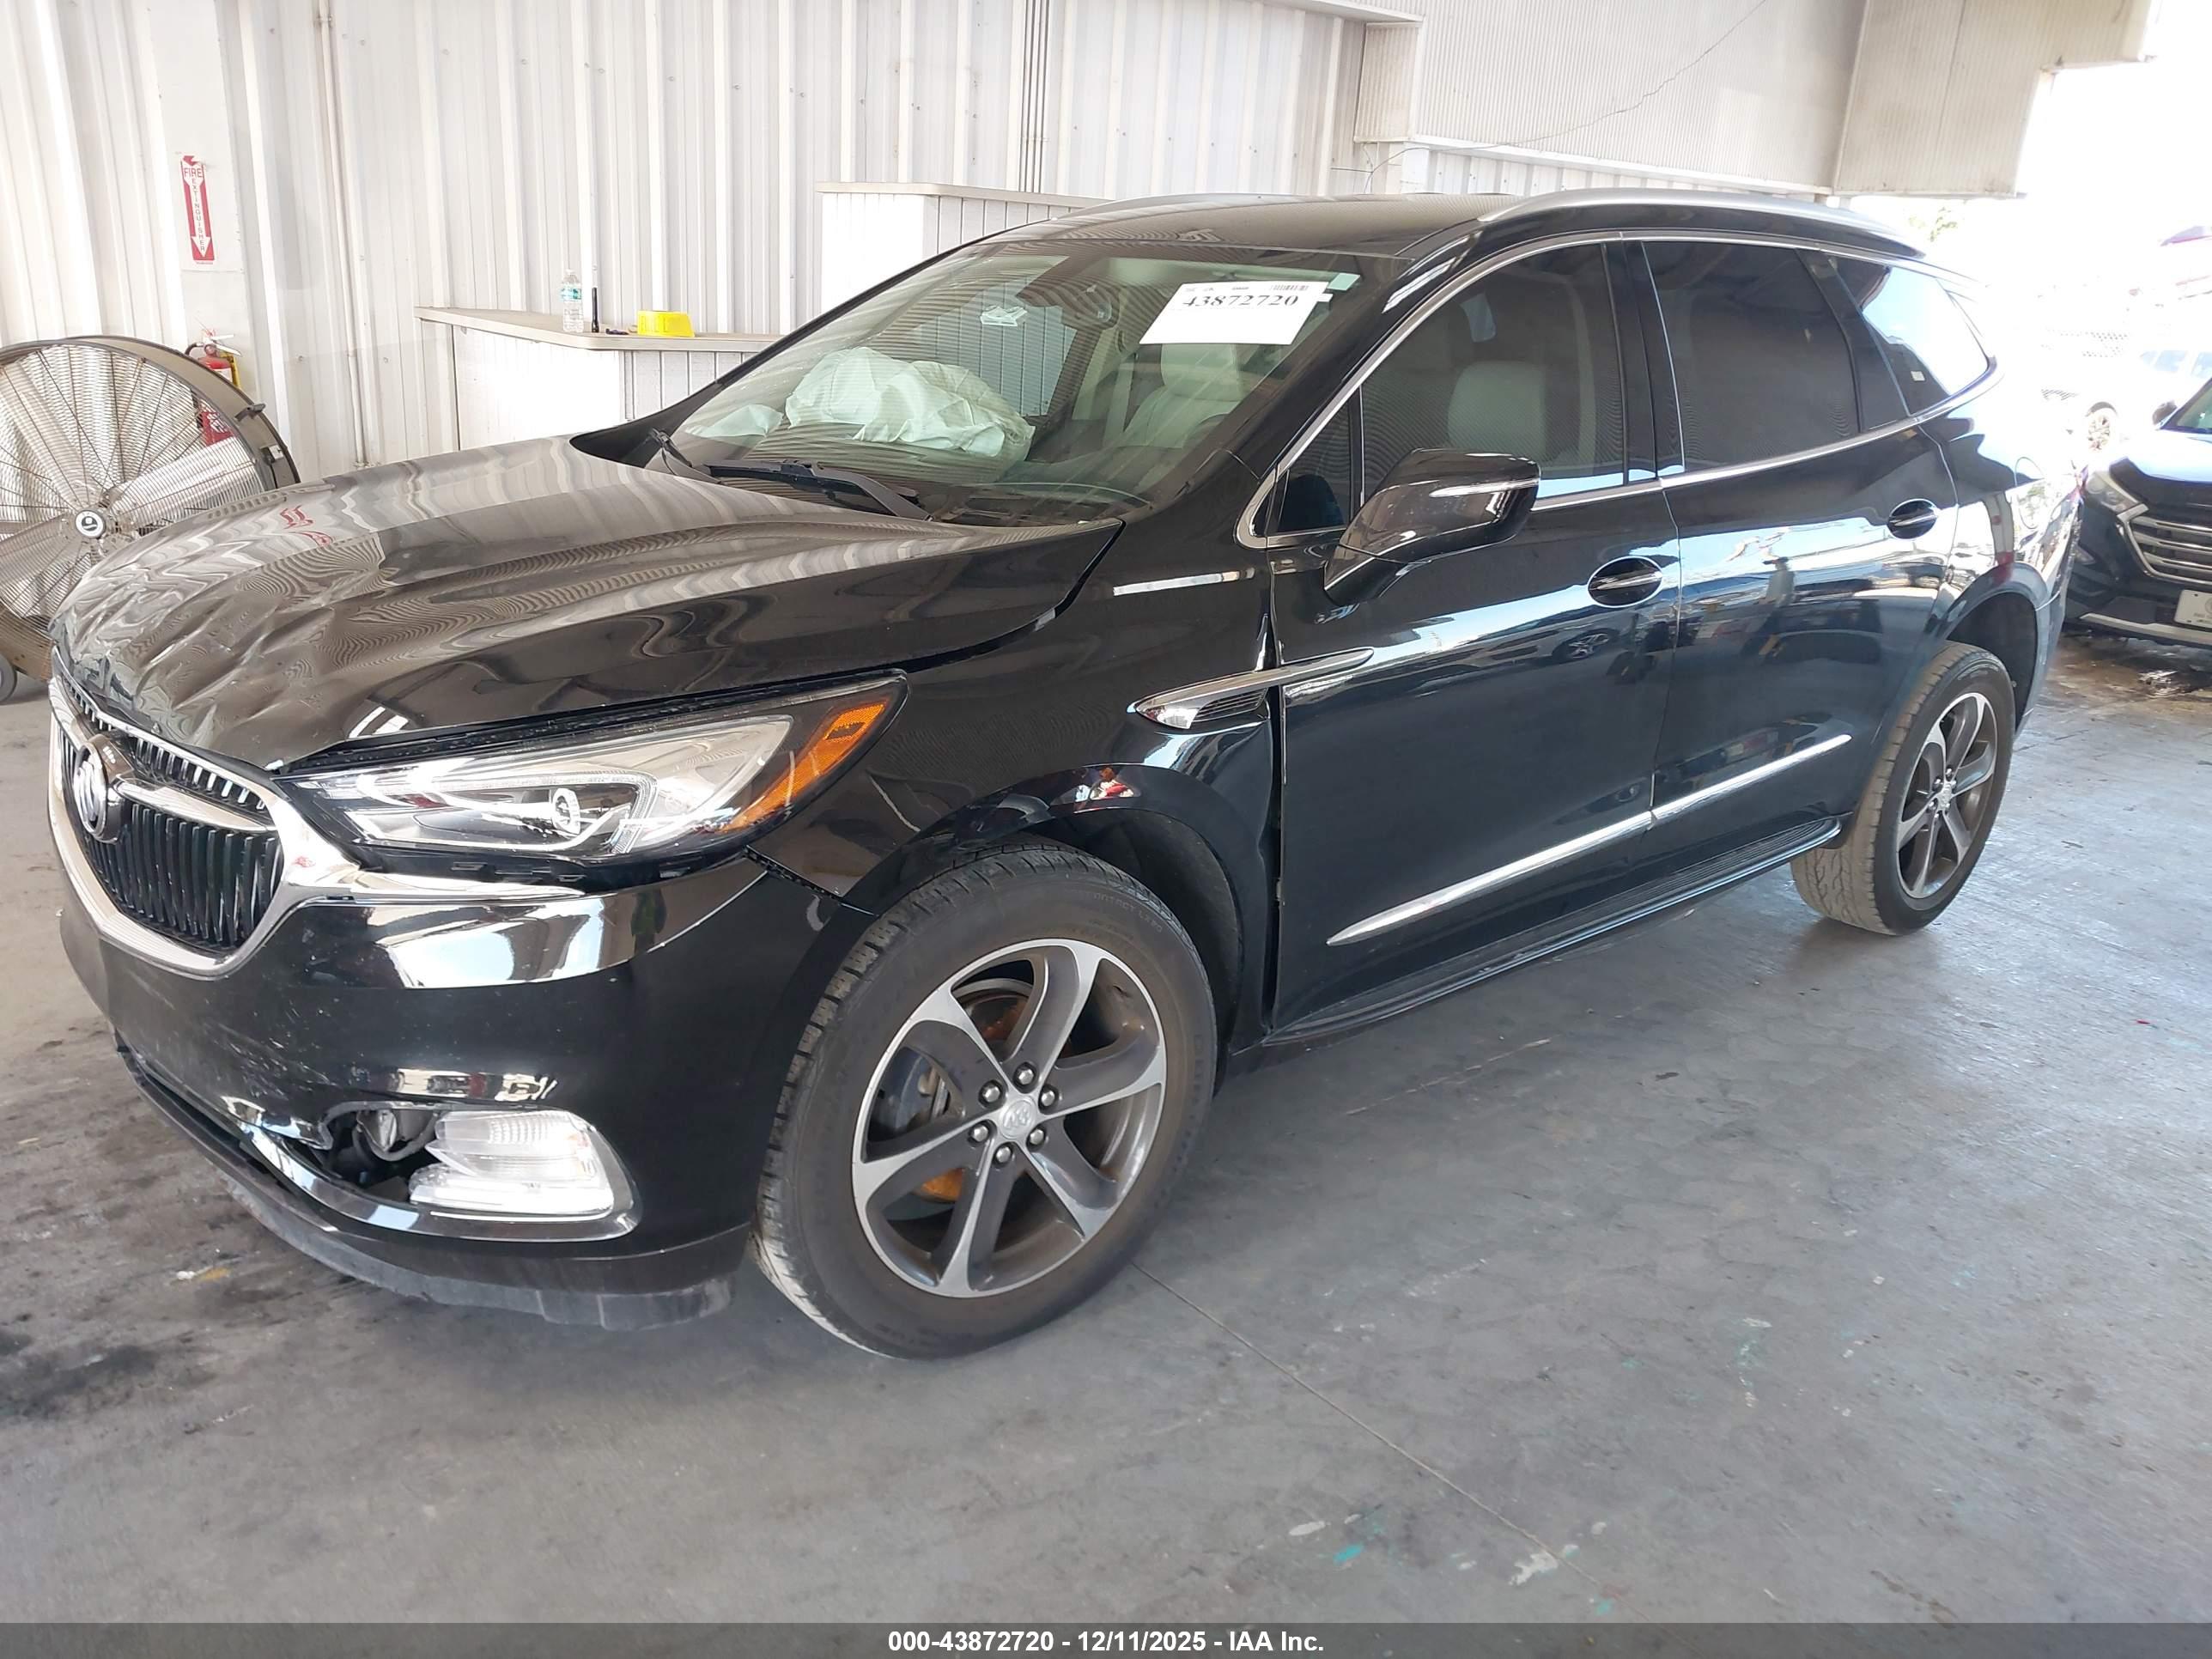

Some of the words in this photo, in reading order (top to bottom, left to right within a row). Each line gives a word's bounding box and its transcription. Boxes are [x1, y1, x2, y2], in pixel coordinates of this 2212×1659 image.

[184, 167, 203, 178] FIRE
[191, 178, 205, 252] EXTINGUISHER
[1182, 295, 1299, 307] 43872720
